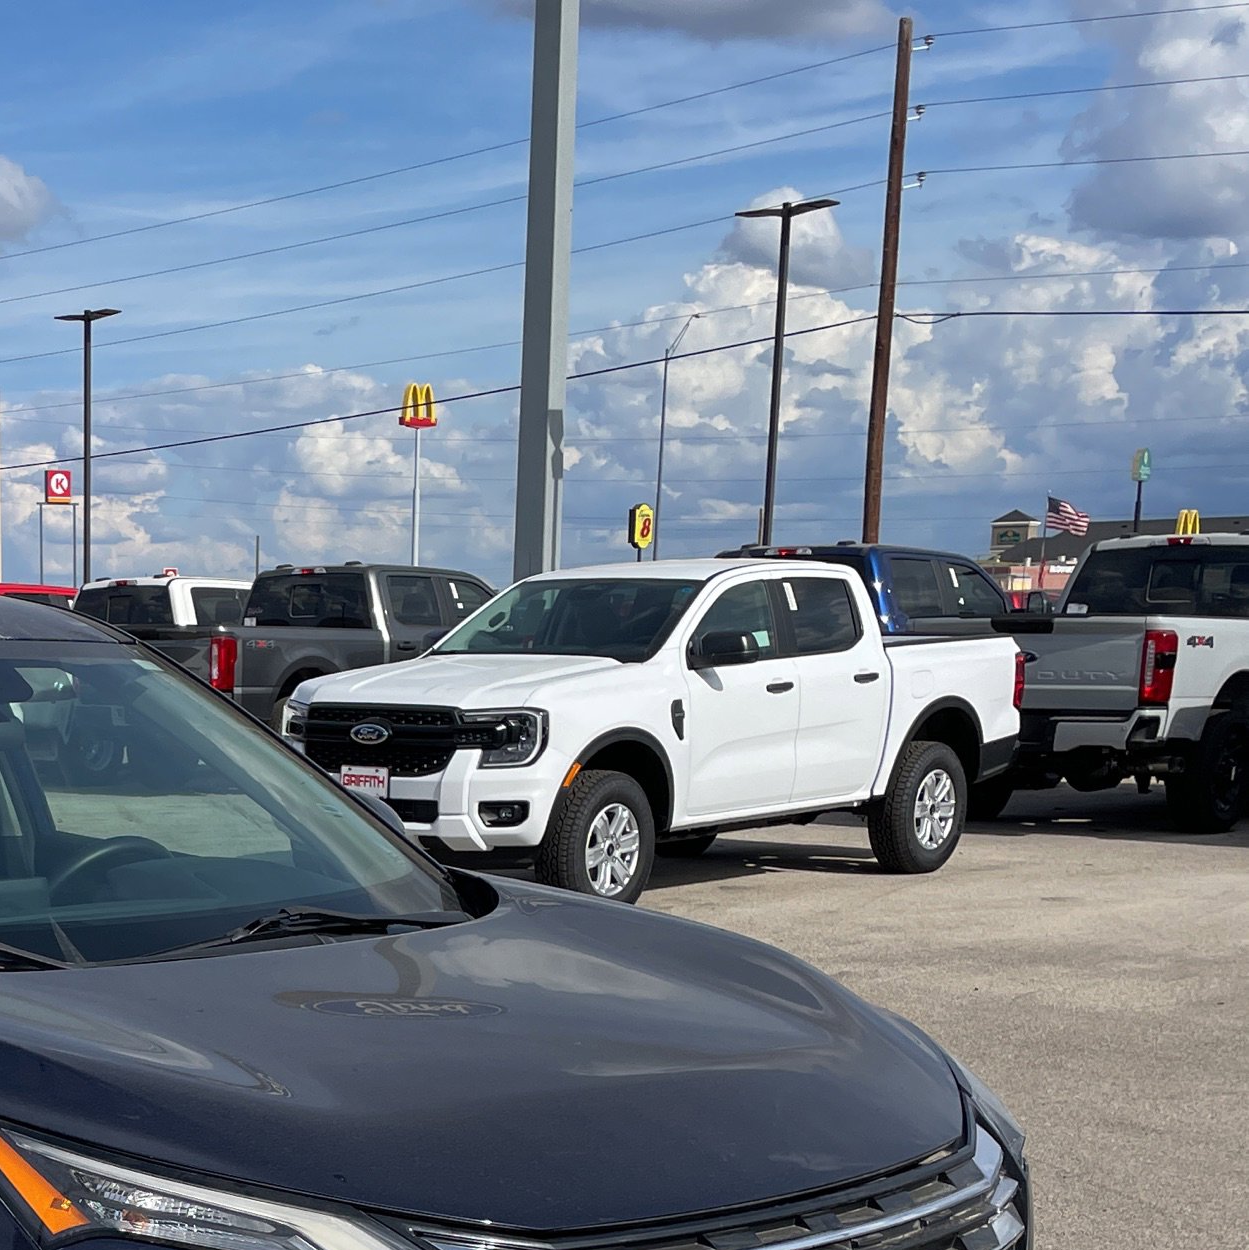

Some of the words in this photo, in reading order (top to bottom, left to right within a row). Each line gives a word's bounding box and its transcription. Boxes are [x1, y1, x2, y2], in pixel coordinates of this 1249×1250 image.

[640, 517, 651, 538] 8
[1037, 671, 1127, 680] DUTY
[343, 774, 385, 788] GRIFFITH
